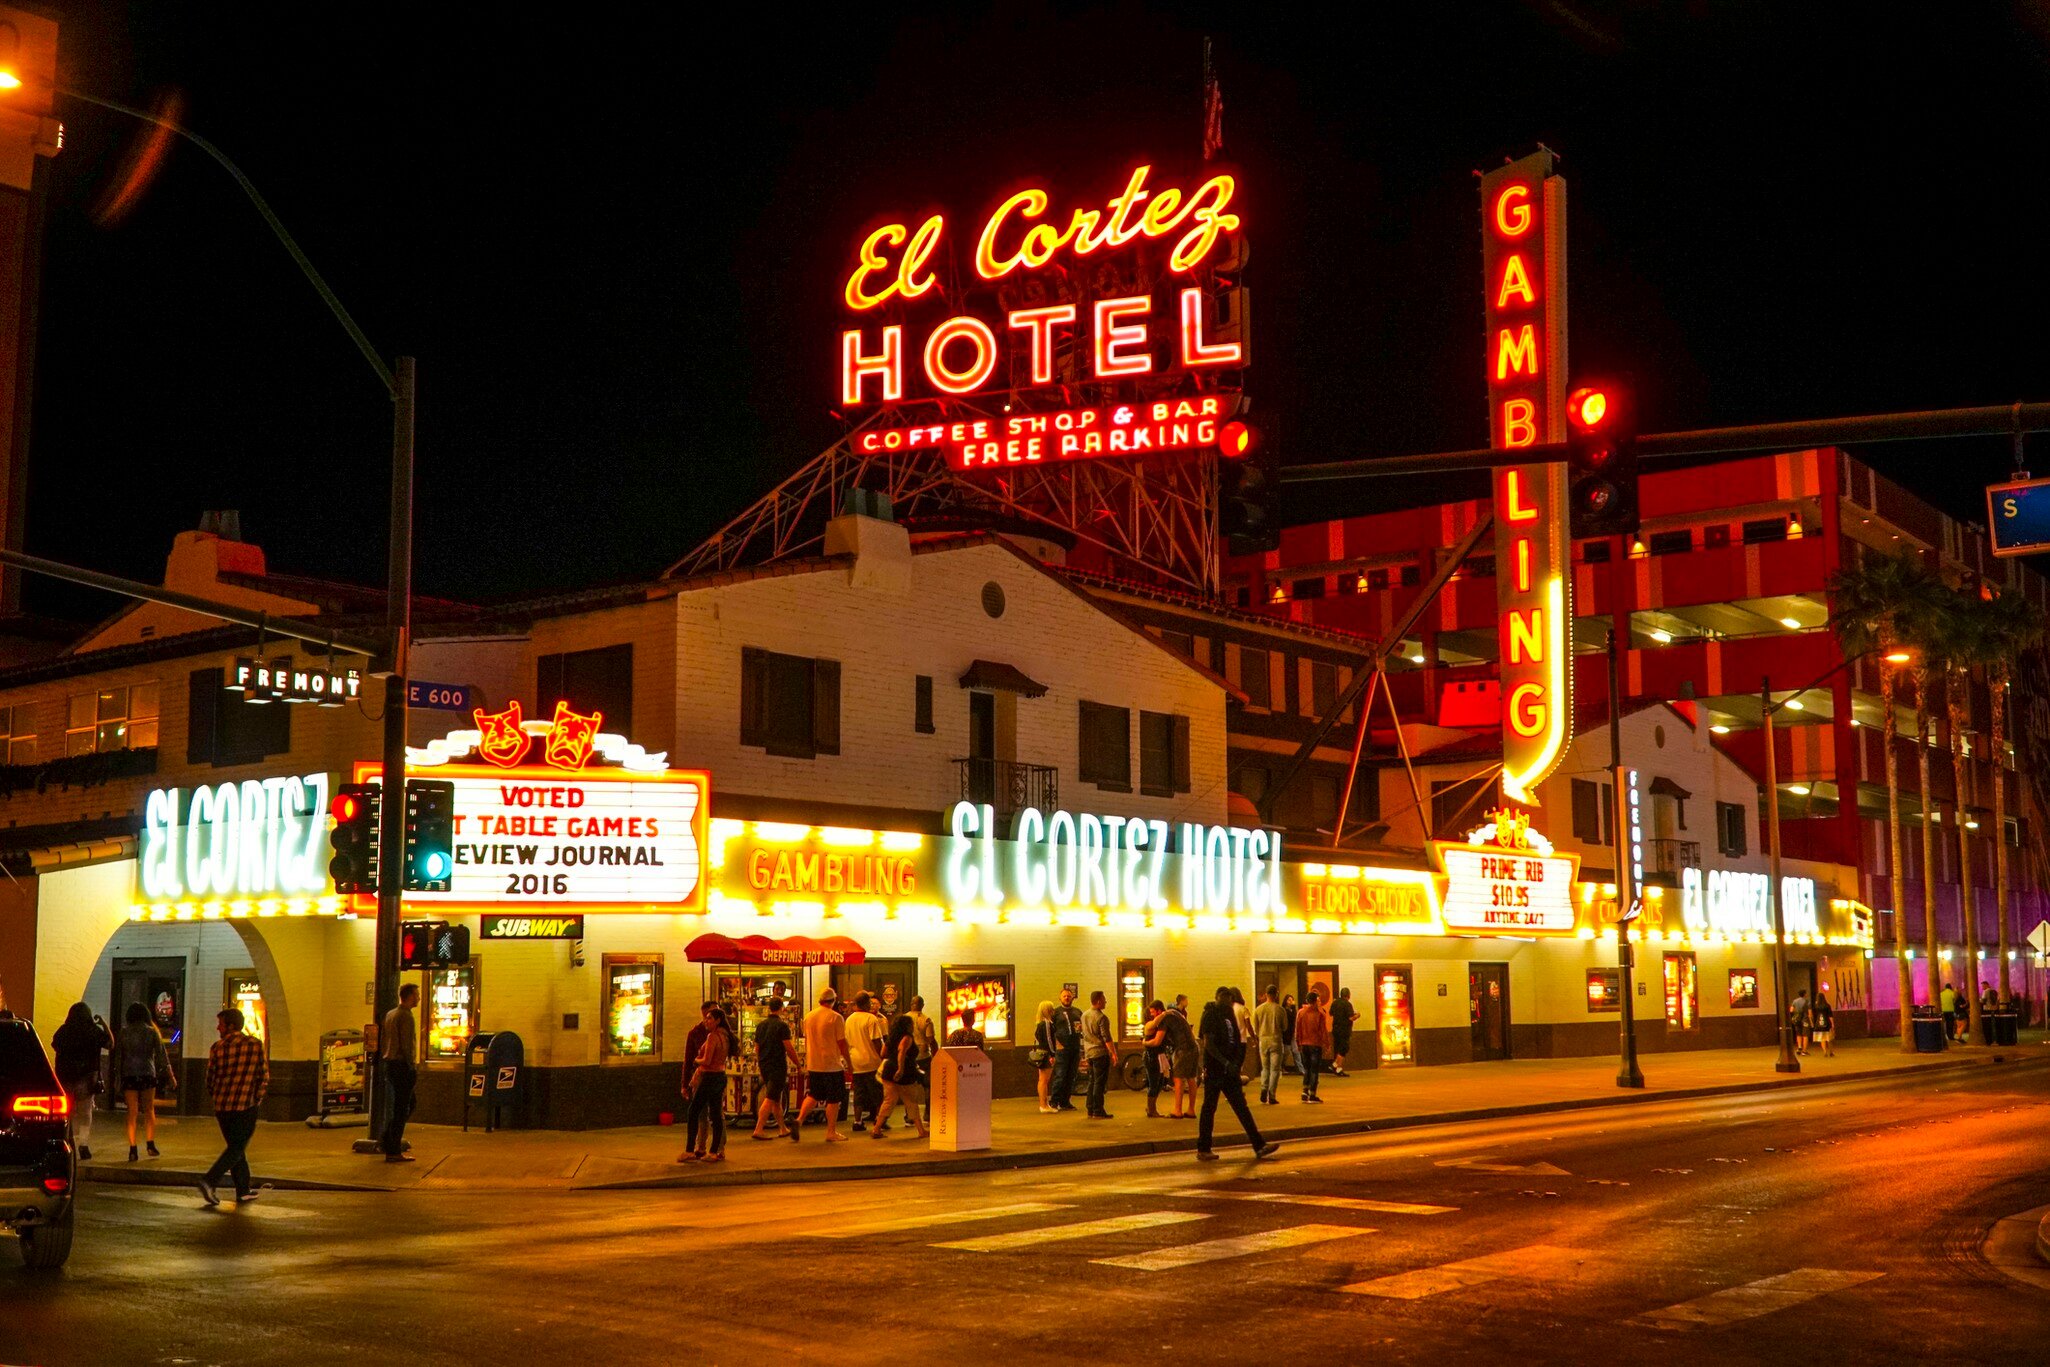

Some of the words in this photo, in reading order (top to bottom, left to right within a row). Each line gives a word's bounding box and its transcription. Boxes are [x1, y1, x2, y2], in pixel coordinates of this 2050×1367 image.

[844, 214, 943, 310] El
[975, 163, 1240, 280] Cortez
[843, 286, 1242, 405] HOTEL
[863, 421, 988, 450] COFFEE
[1008, 411, 1096, 434] SHOP
[1113, 406, 1133, 424] &
[1153, 398, 1217, 421] BAR
[963, 437, 1041, 466] FREE
[1061, 421, 1215, 455] PARKING
[1497, 185, 1547, 738] GAMBLING
[2003, 498, 2018, 518] S
[238, 666, 360, 696] FREMONT
[410, 686, 420, 701] E
[429, 688, 463, 706] 600
[500, 785, 585, 808] VOTED
[143, 787, 184, 897] EL
[186, 772, 329, 895] CORTEZ
[477, 815, 558, 837] TABLE
[567, 817, 659, 838] GAMES
[455, 844, 539, 865] EVIEW
[545, 845, 664, 867] JOURNAL
[951, 800, 1005, 903] EL
[1017, 807, 1168, 909] CORTEZ
[1182, 822, 1287, 915] HOTEL
[1481, 857, 1517, 881] PRIME
[1525, 860, 1544, 882] RIB
[505, 873, 569, 895] 2016
[749, 847, 916, 896] GAMBLING
[1306, 883, 1362, 914] FLOOR
[1365, 886, 1422, 916] SHOWS
[490, 917, 577, 937] SUBWAY
[806, 951, 822, 963] HOT
[824, 950, 845, 963] DOGS
